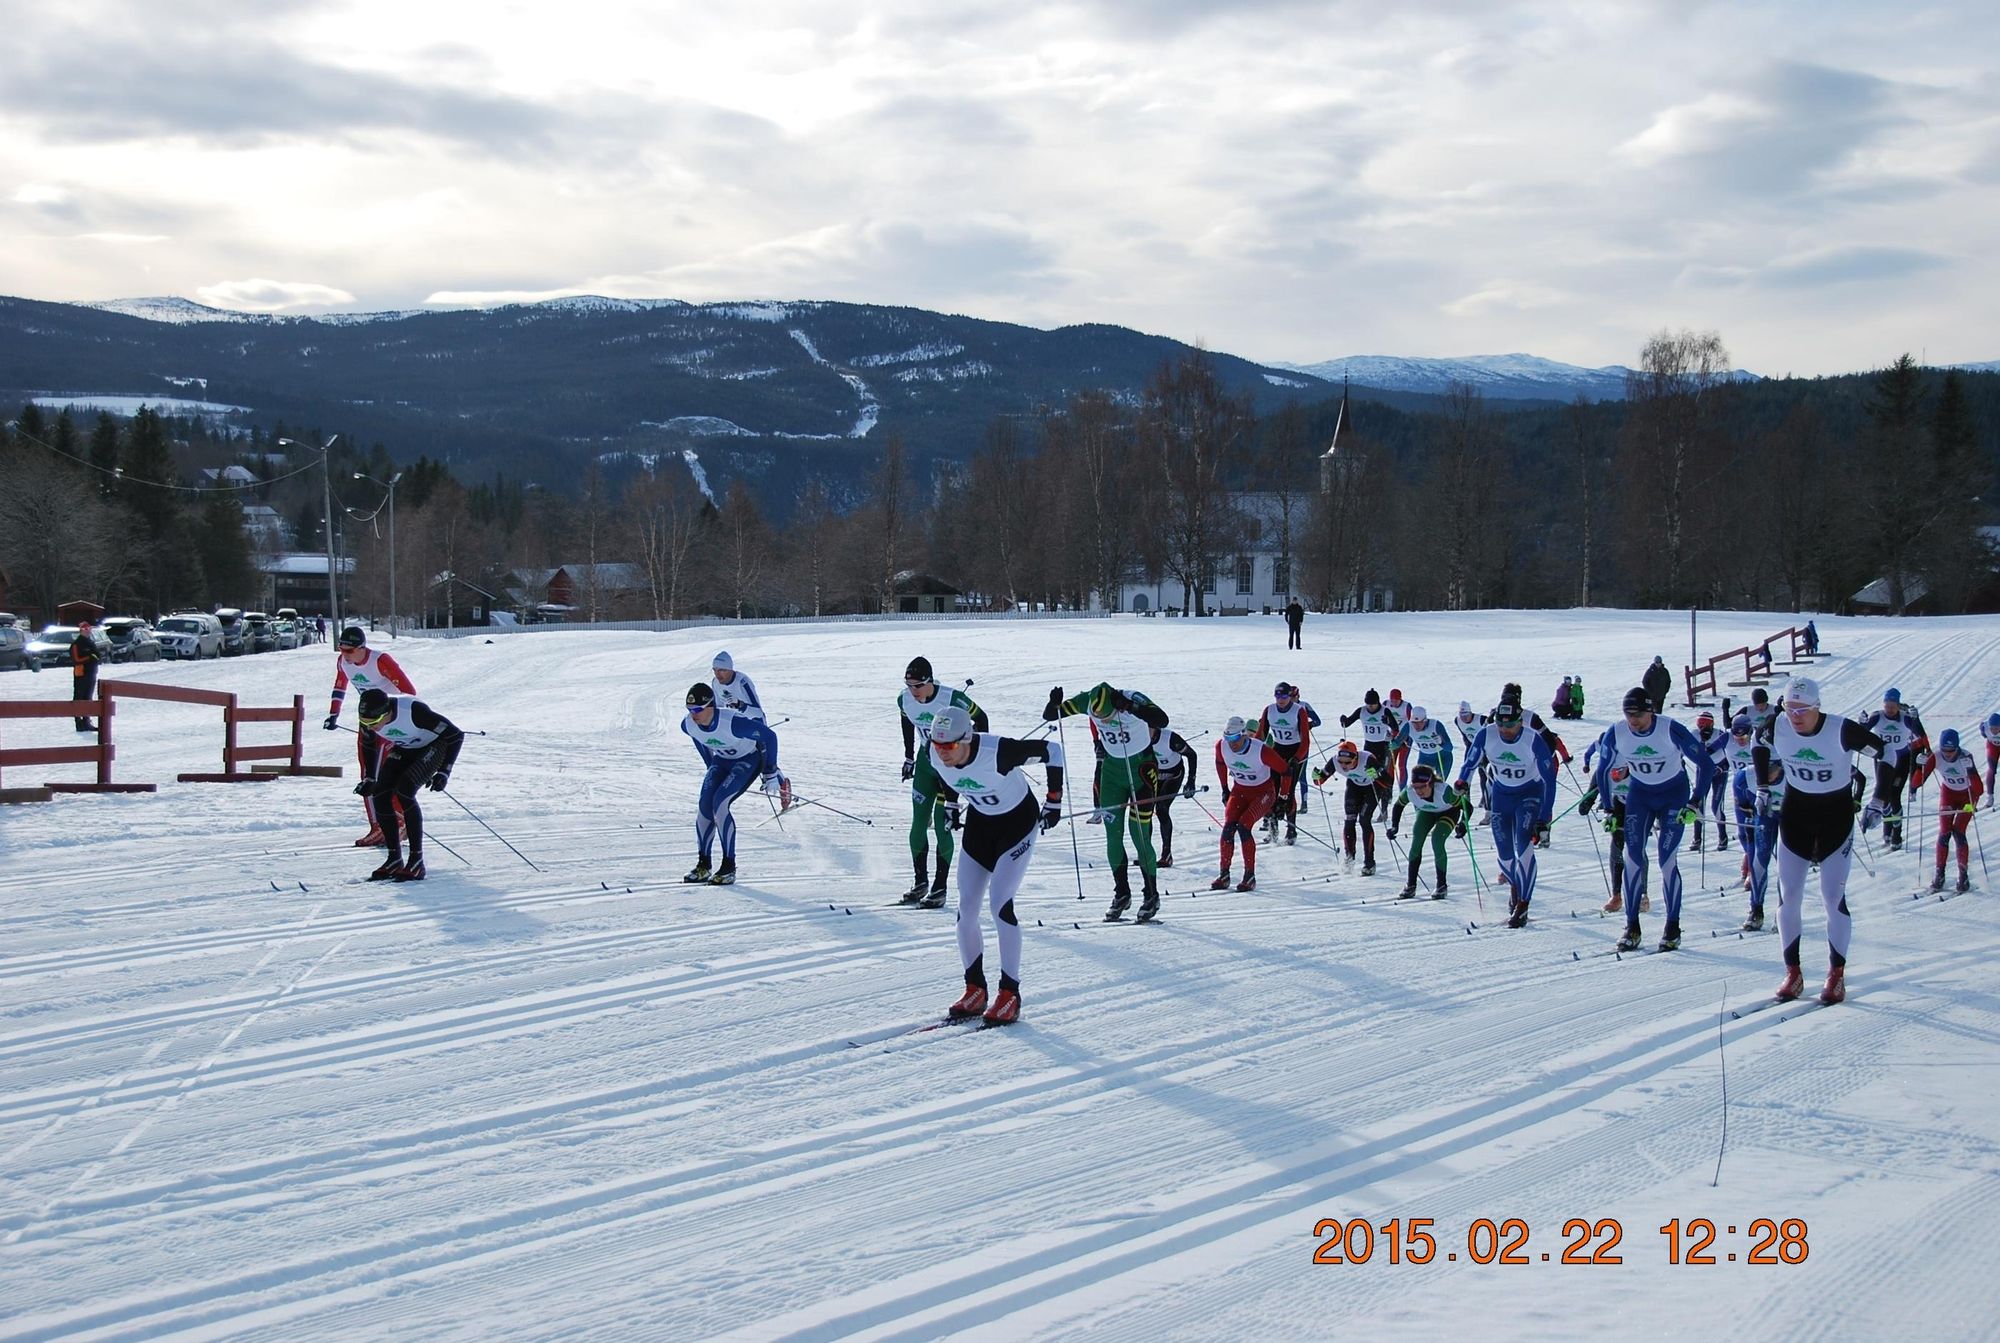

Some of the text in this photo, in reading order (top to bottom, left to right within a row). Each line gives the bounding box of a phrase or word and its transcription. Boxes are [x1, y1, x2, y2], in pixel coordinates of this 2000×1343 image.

[1271, 728, 1292, 741] 112
[1364, 725, 1381, 734] 131
[1627, 760, 1667, 774] 107
[1786, 763, 1833, 783] 108
